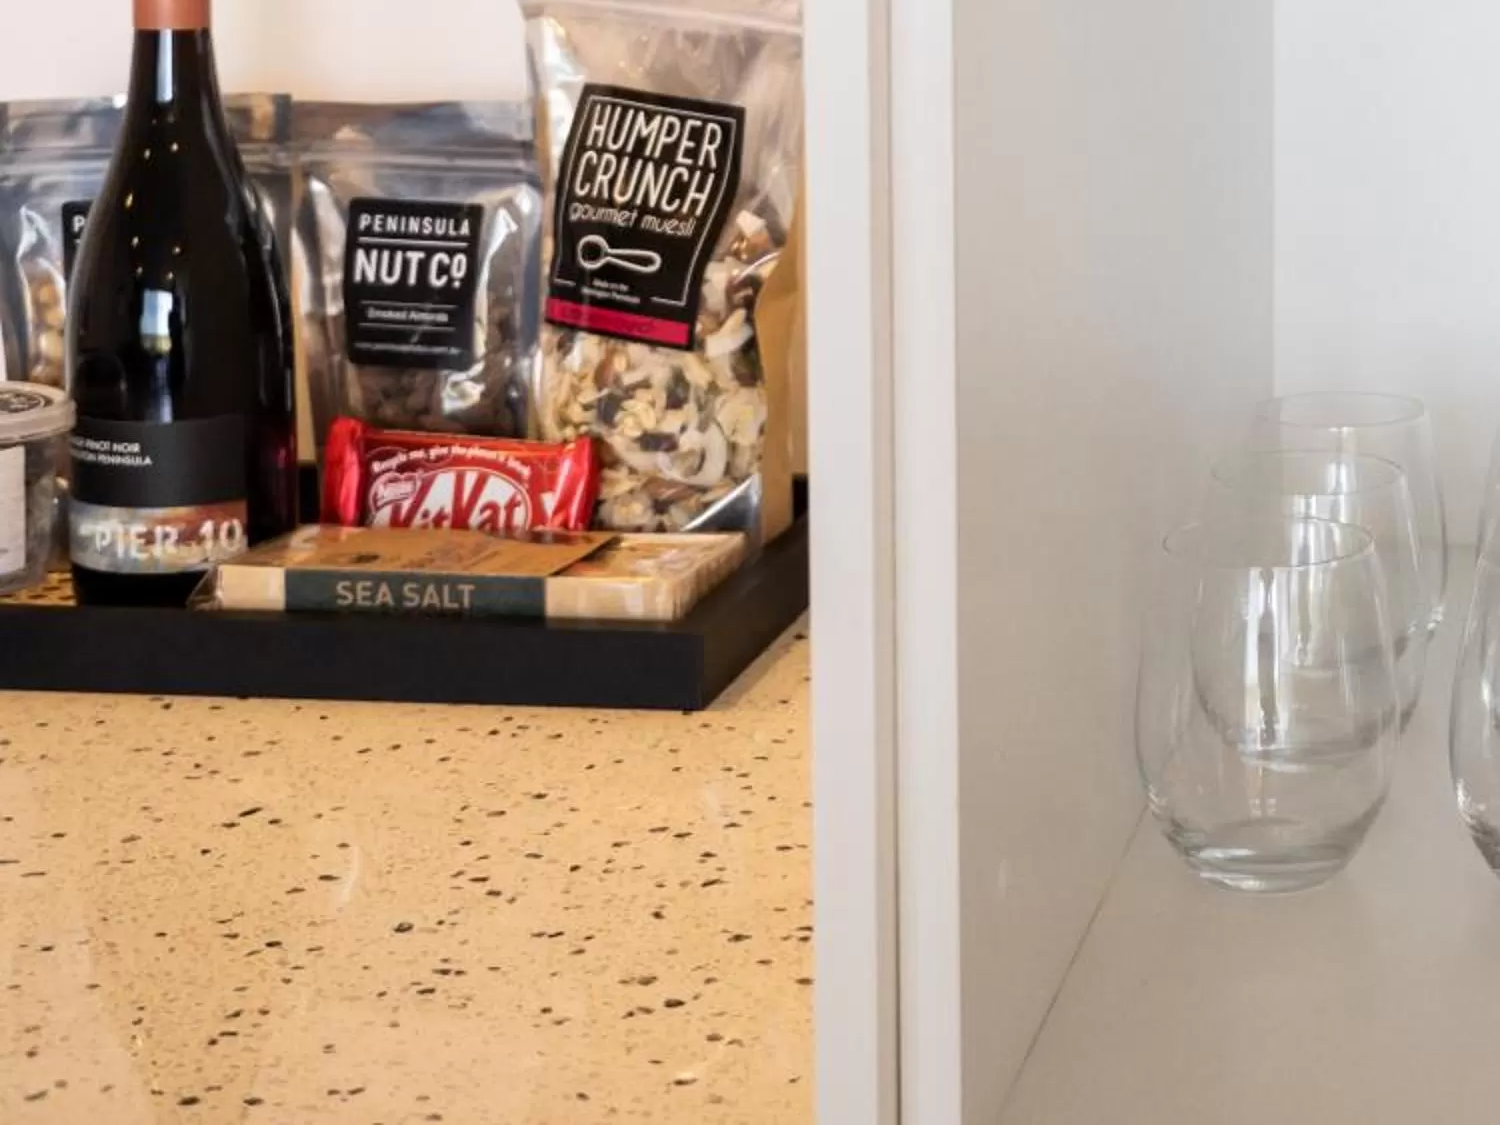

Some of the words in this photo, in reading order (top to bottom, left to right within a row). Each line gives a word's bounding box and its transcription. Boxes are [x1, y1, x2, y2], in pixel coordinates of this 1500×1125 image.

[586, 104, 723, 168] HUMPER
[573, 151, 715, 216] CRUNCH
[358, 213, 470, 236] PENINSULA
[569, 202, 638, 226] gourmet
[641, 214, 697, 236] muesli
[353, 248, 426, 287] NUT
[112, 442, 141, 453] NOIR
[335, 580, 395, 606] SEA
[402, 581, 476, 609] SALT
